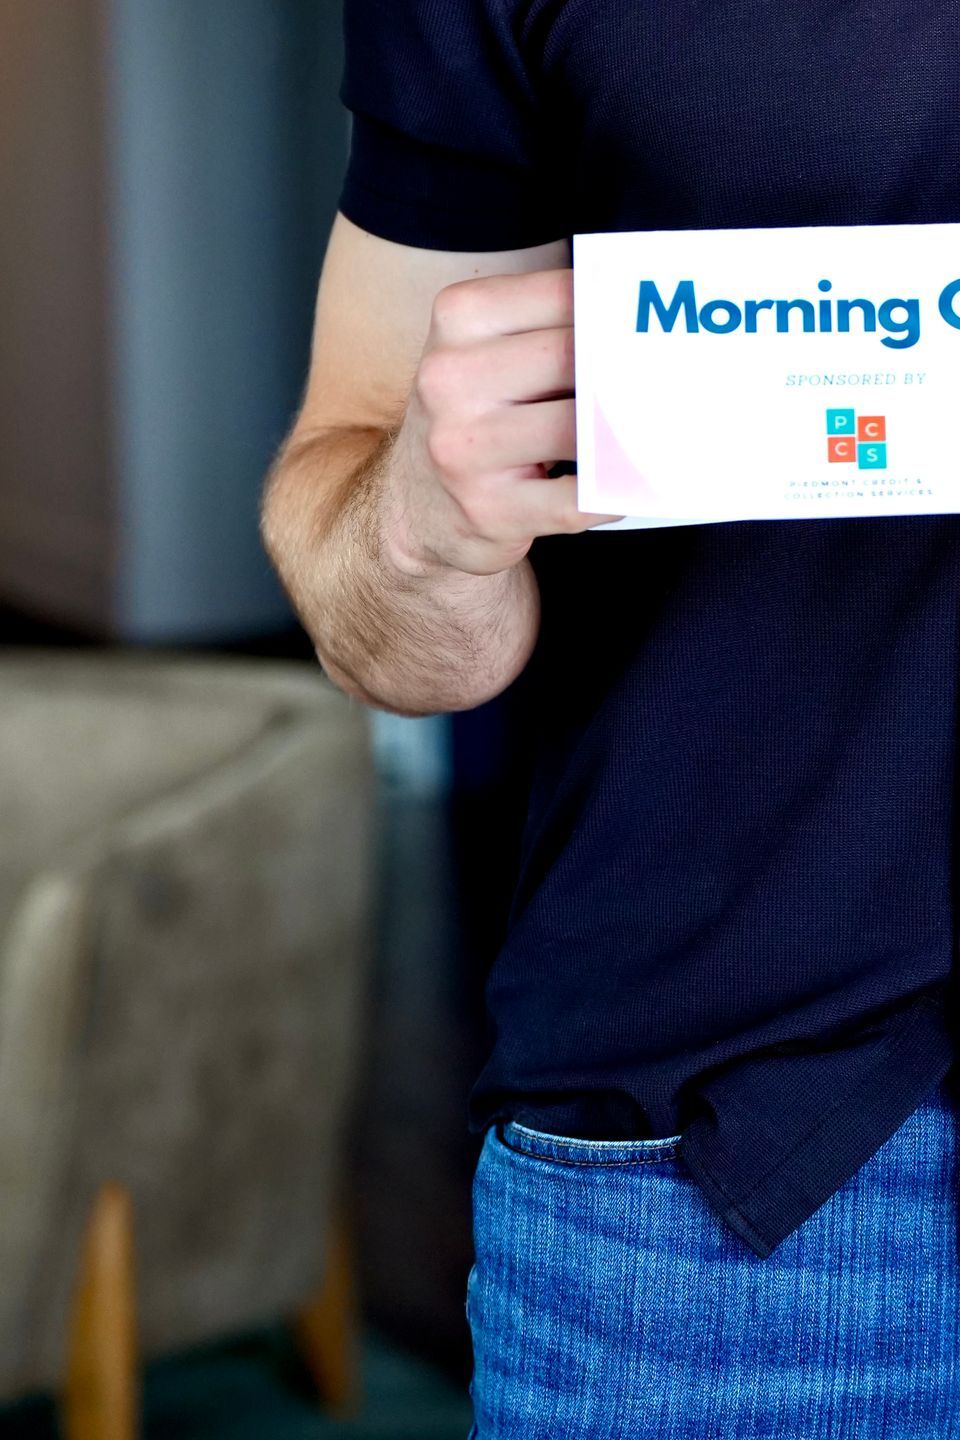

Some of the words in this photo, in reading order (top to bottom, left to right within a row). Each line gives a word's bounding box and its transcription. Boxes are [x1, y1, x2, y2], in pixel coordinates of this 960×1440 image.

[635, 279, 921, 350] Morning
[785, 372, 897, 387] SPONSORED
[904, 372, 927, 385] BY
[834, 415, 848, 430] P
[865, 422, 880, 437] C
[834, 441, 848, 456] C
[866, 448, 878, 463] S
